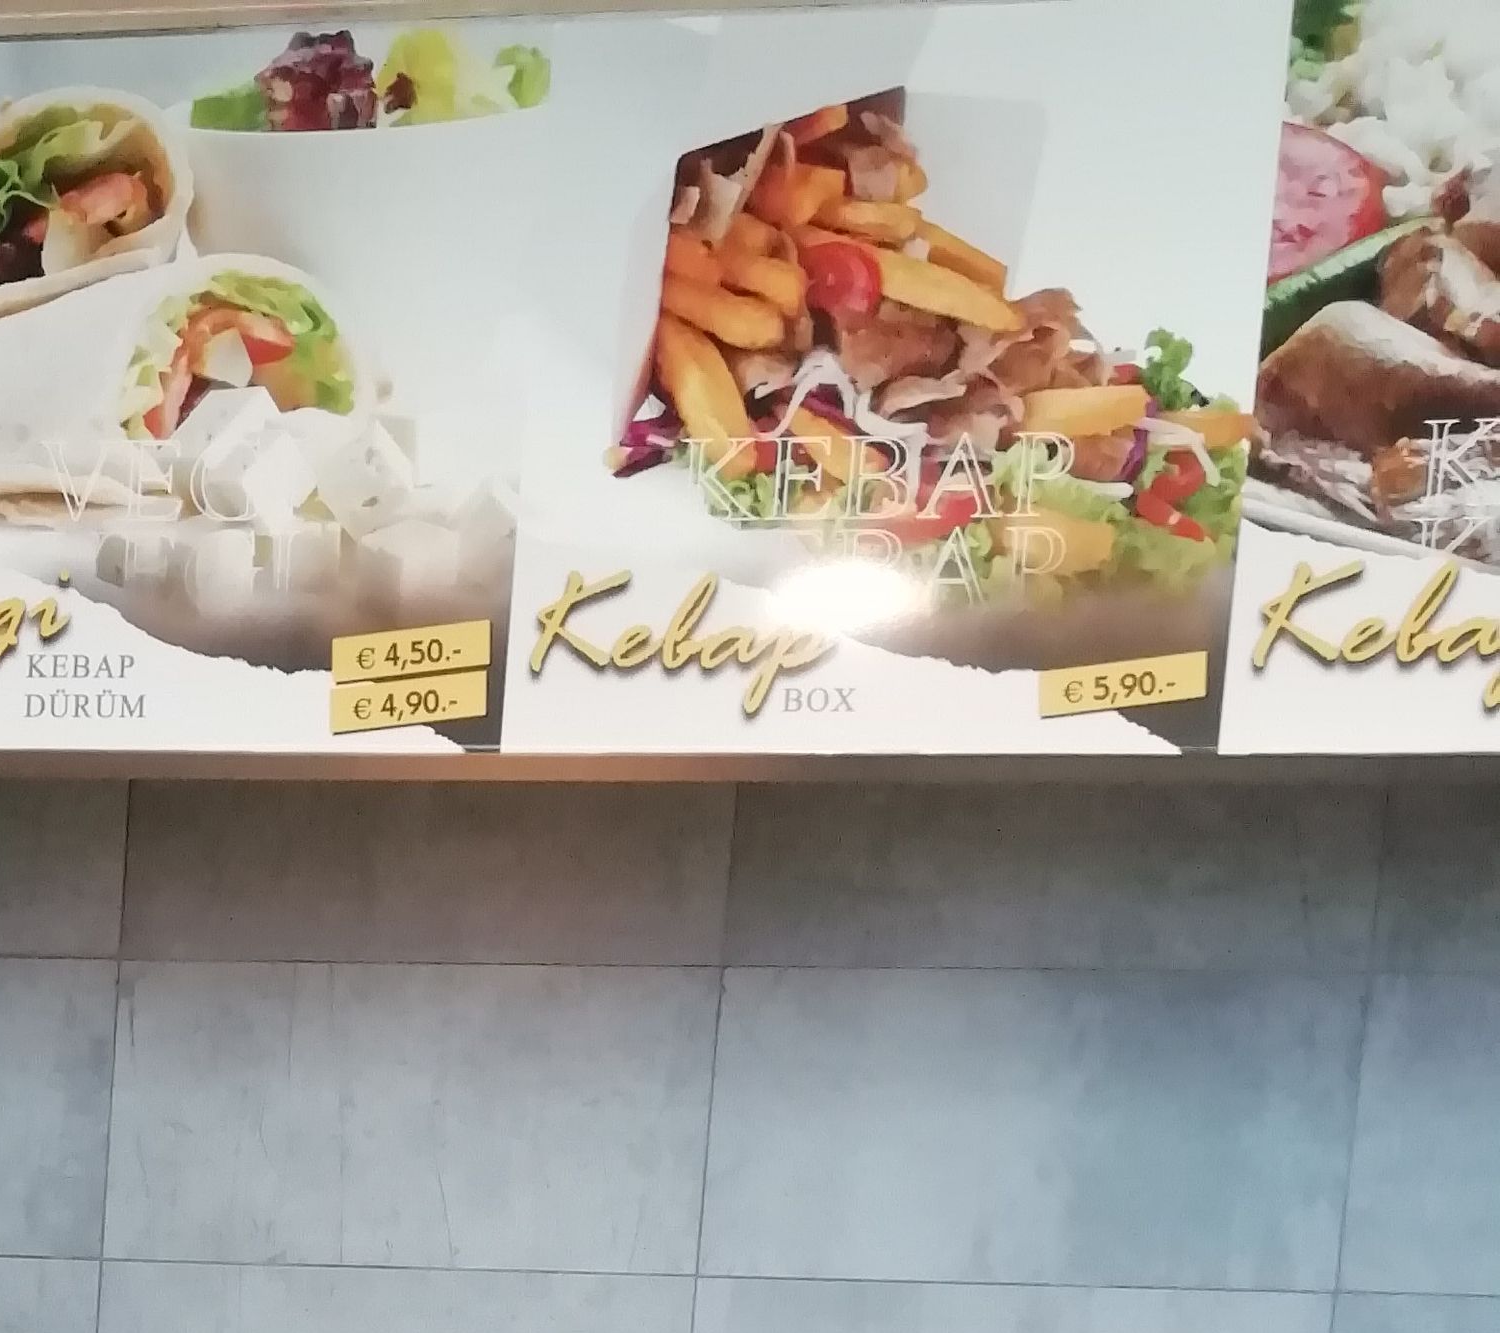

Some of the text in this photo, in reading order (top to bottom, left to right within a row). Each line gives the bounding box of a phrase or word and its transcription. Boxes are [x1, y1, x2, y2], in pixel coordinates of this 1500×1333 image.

[681, 431, 1077, 521] KEBAP
[356, 637, 462, 670] € 4,50.-
[530, 570, 840, 716] Kebap
[25, 654, 136, 680] KEBAP
[782, 687, 856, 714] BOX
[1063, 670, 1178, 704] € 5,90.-
[23, 690, 145, 719] DÜRÜM
[352, 688, 458, 720] € 4,90.-
